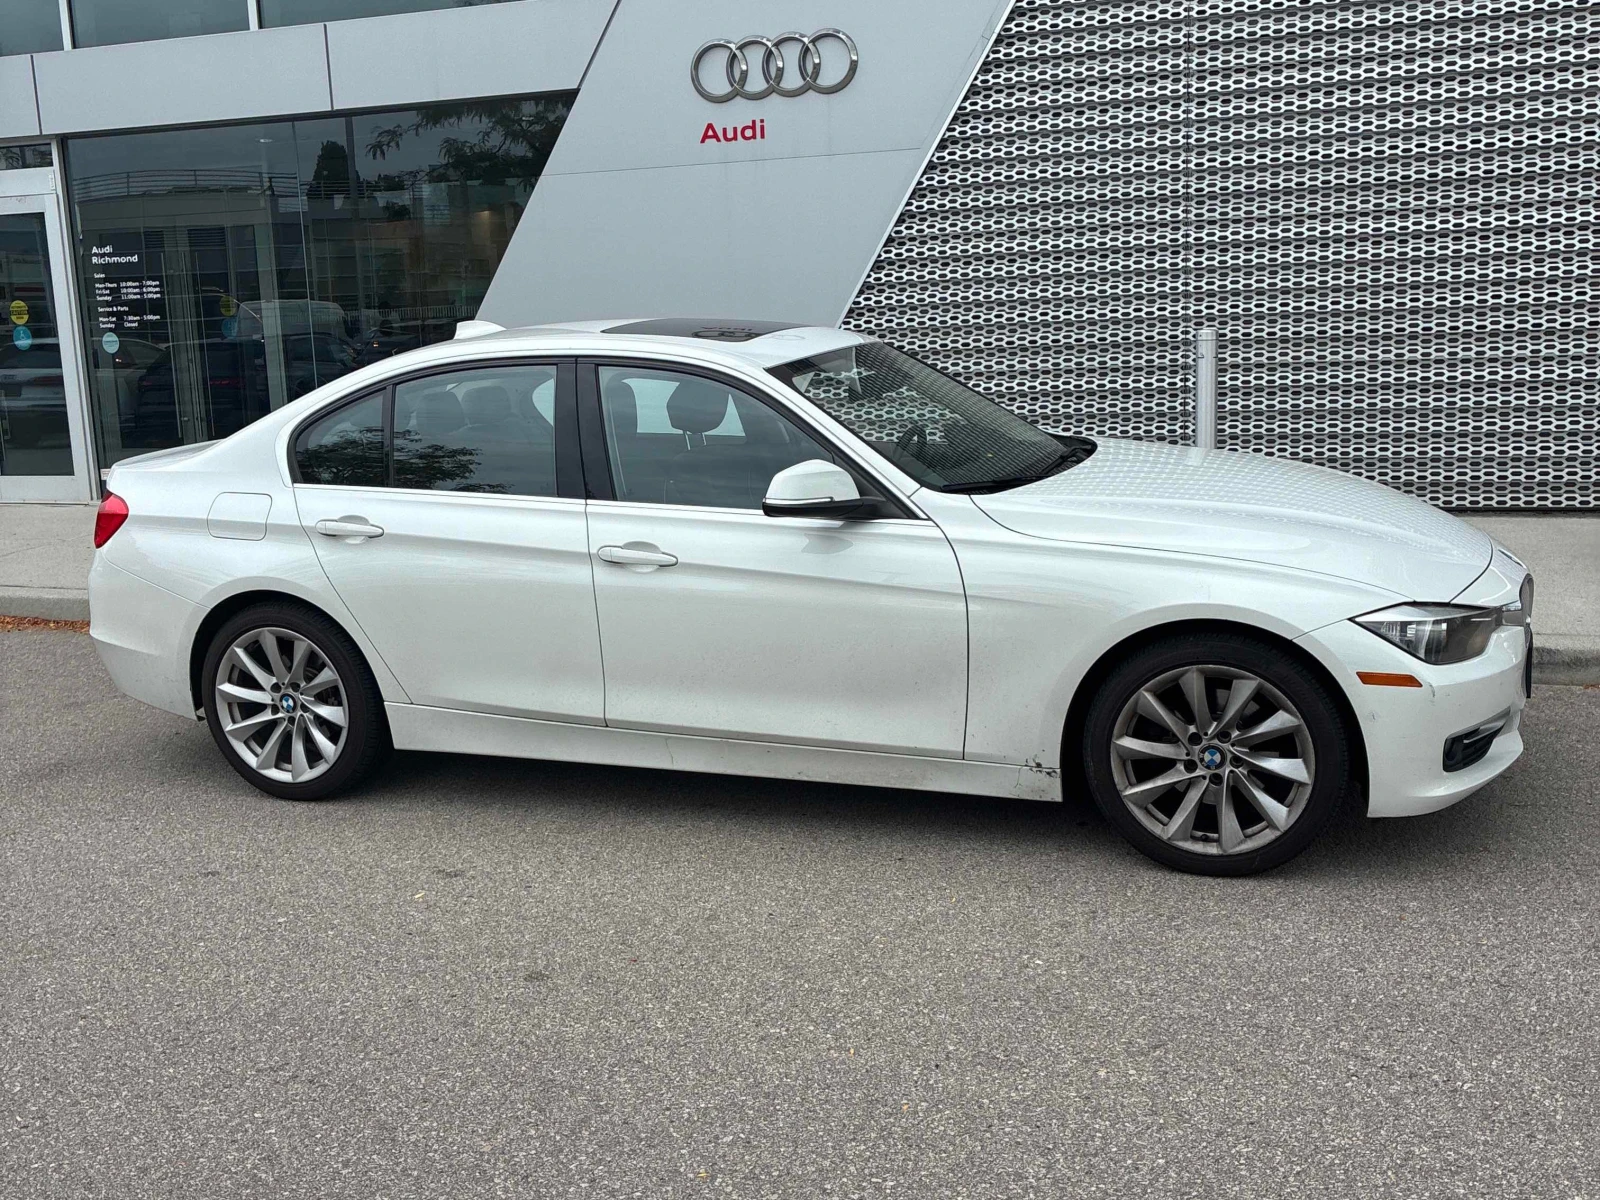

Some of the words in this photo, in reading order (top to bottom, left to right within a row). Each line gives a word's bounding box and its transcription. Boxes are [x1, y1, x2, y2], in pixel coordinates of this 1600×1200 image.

[700, 118, 765, 144] Audi
[91, 245, 113, 254] Audi
[92, 254, 138, 264] Richmond
